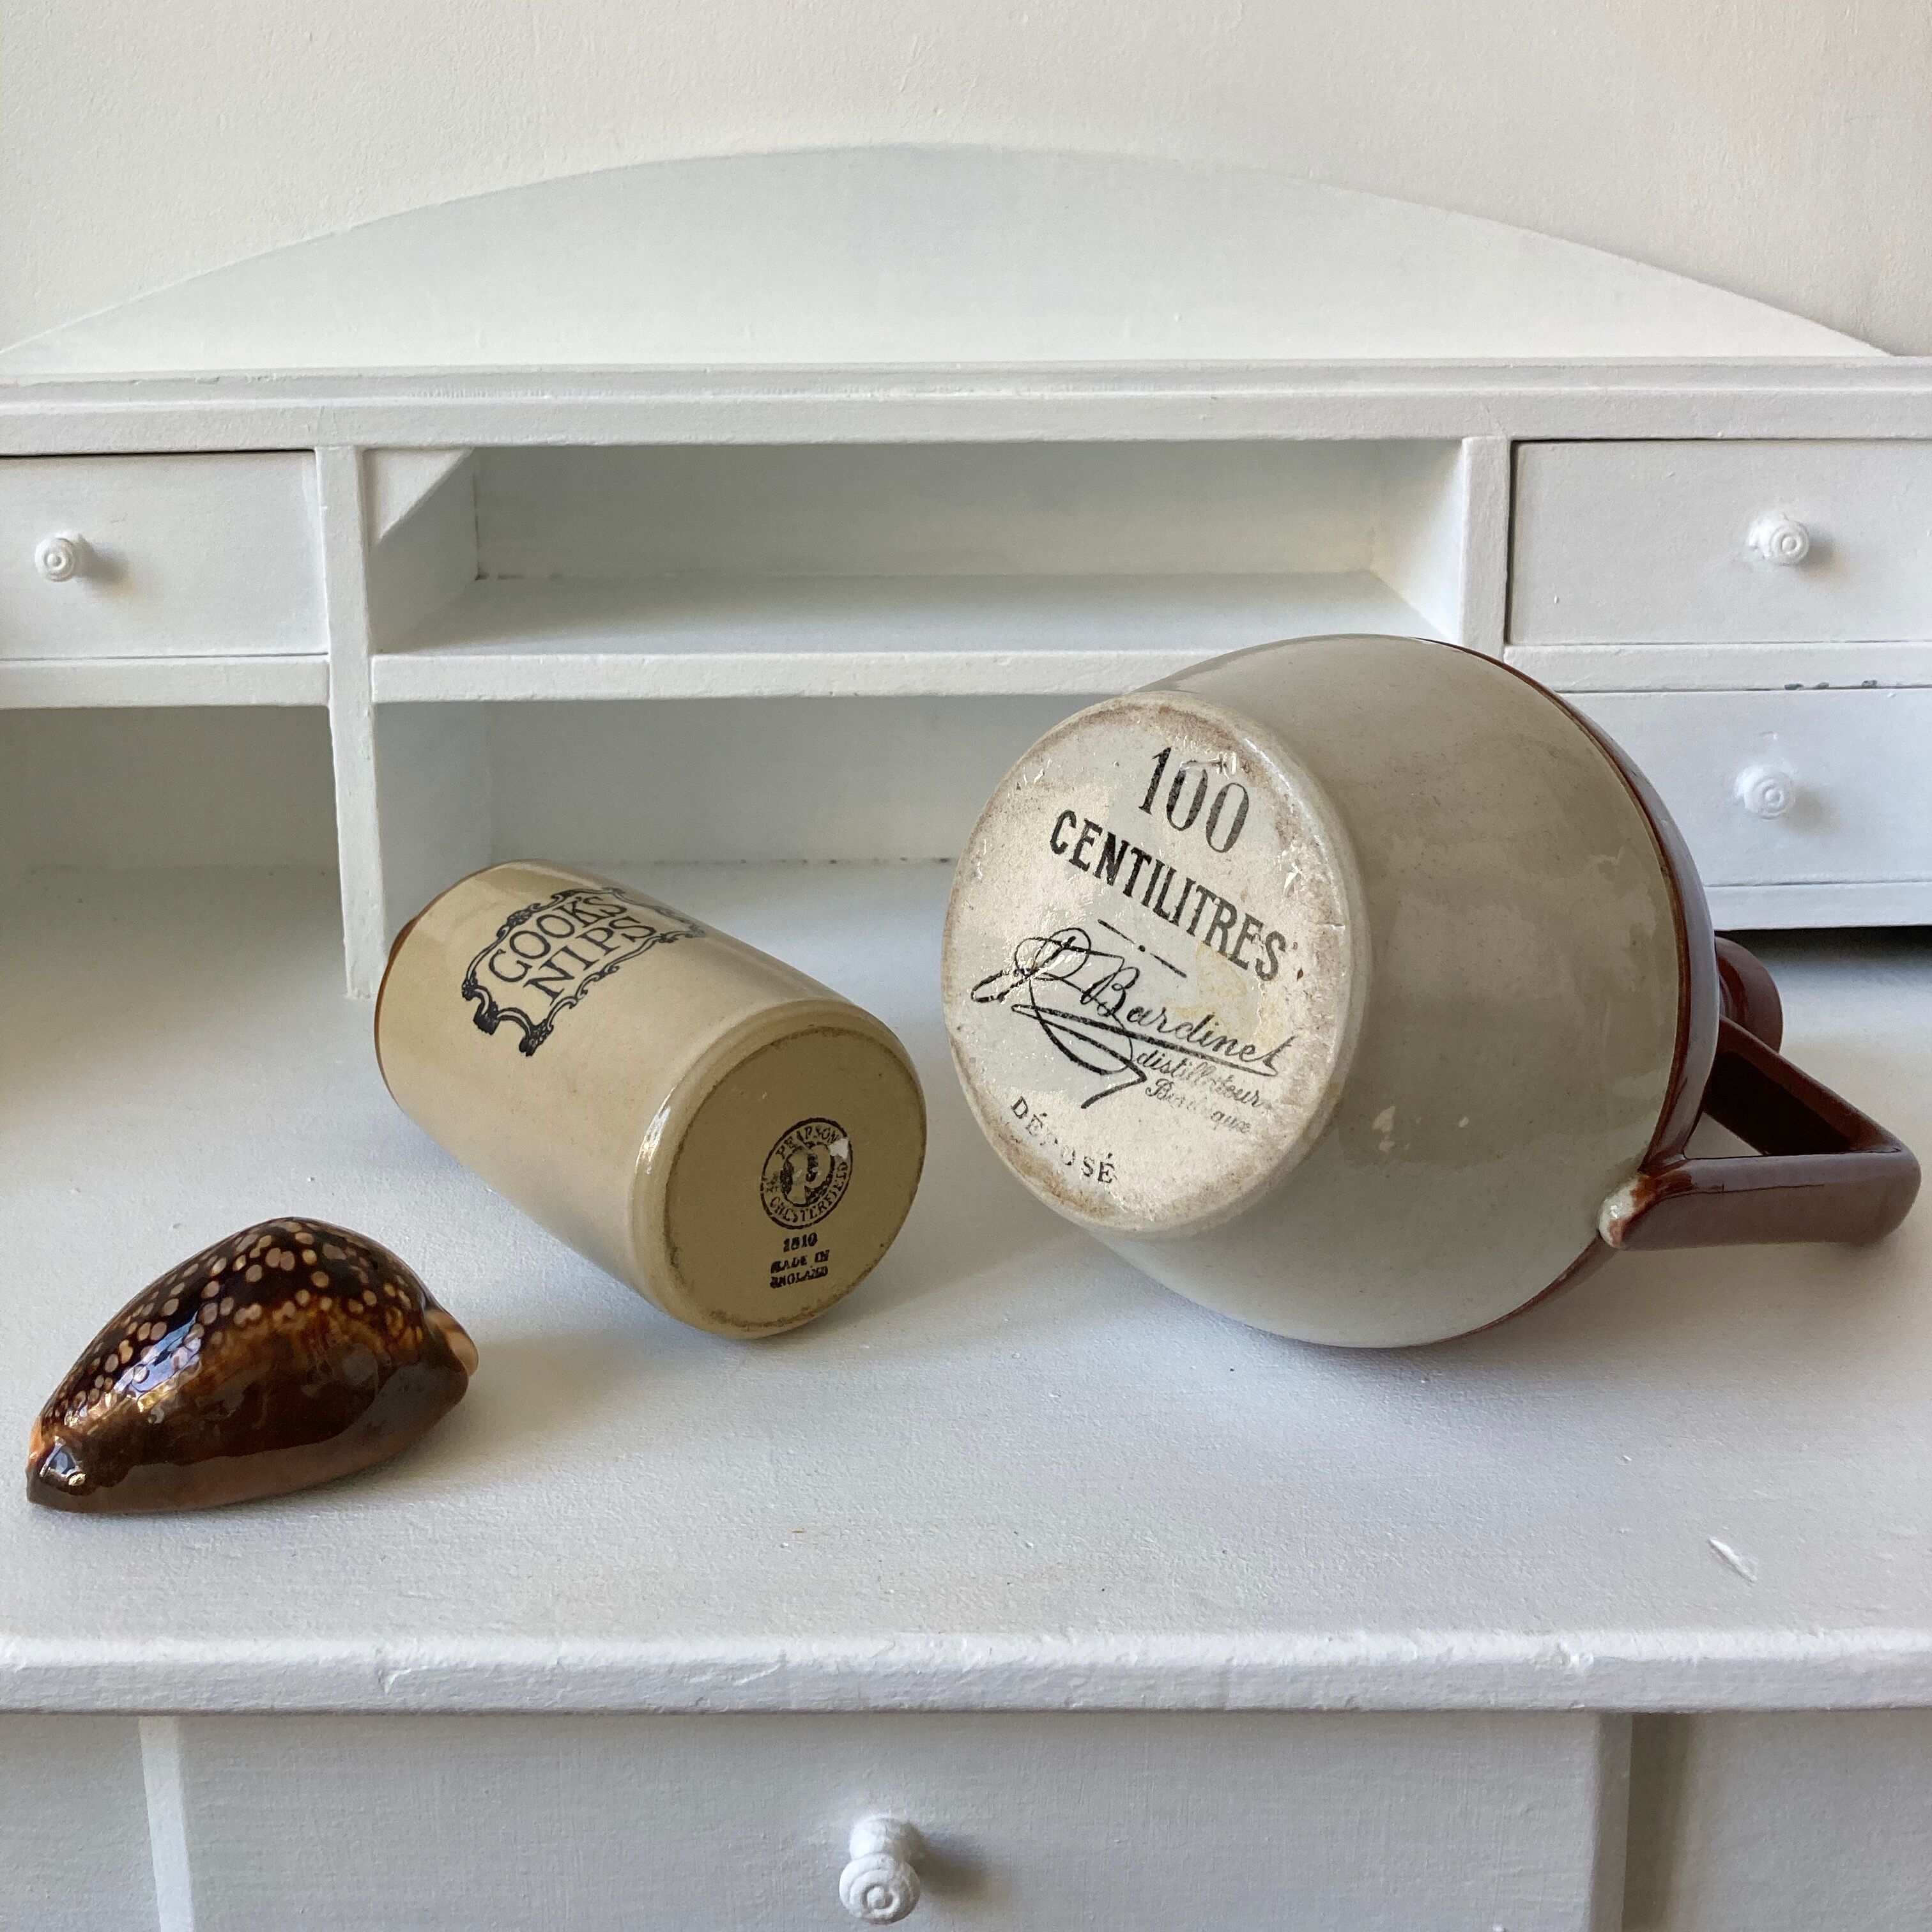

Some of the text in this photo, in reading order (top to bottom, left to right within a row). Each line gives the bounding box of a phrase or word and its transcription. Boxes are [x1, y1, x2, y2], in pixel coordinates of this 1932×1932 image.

[1138, 746, 1250, 854] 100
[1049, 809, 1286, 982] CENTILITRES
[523, 916, 657, 1006] NIPS
[1010, 1096, 1116, 1184] DÉOSÉ
[770, 1249, 831, 1274] MADE IN
